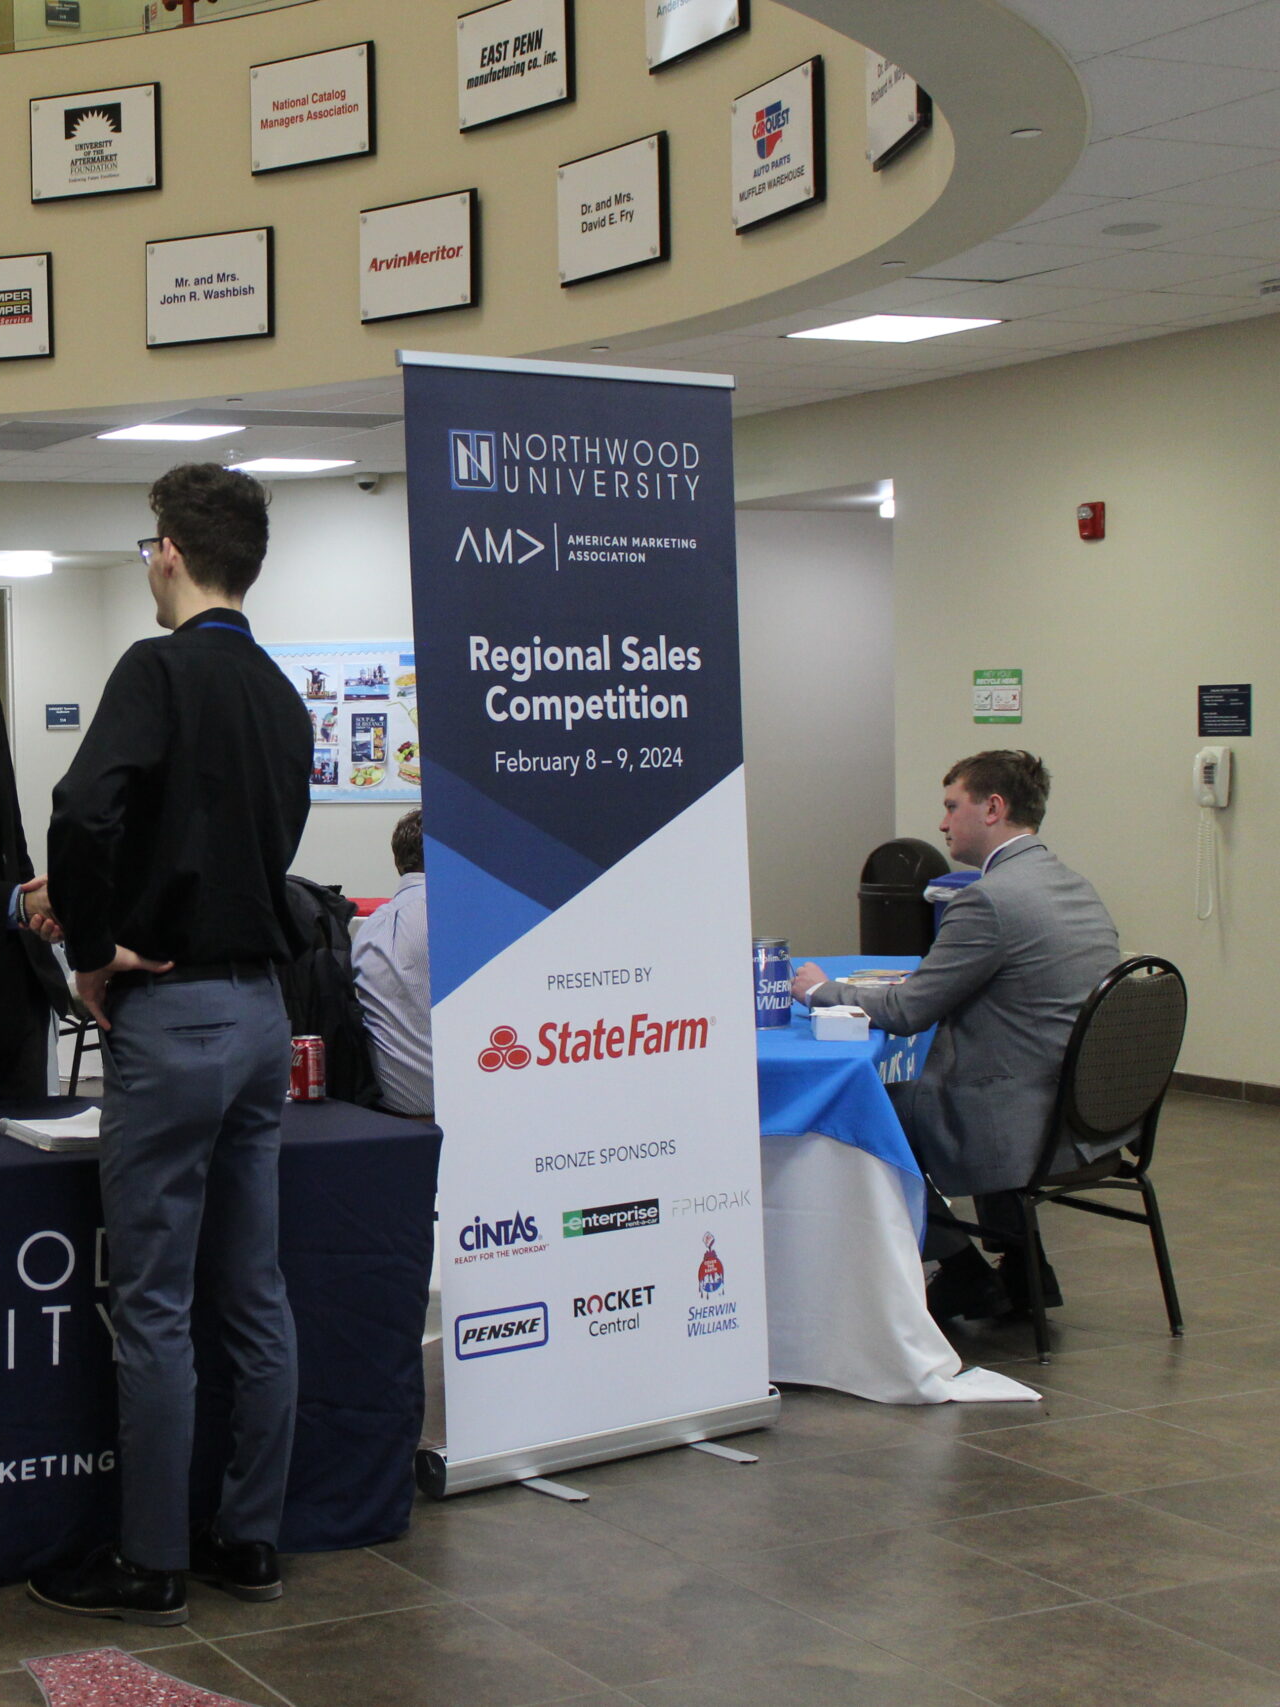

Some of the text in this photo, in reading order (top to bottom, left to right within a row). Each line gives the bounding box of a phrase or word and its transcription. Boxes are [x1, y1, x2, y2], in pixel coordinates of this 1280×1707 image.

[480, 28, 543, 68] EAST PENN
[466, 60, 525, 90] manufacturing
[543, 50, 558, 65] inc.
[272, 89, 346, 111] National Catalog
[260, 103, 359, 130] Managers Association
[752, 107, 790, 141] CARQUEST
[75, 139, 112, 151] UNIVERSITY
[70, 153, 118, 167] AFTERMARKET
[70, 162, 118, 175] FOUNDATION
[753, 153, 791, 179] AUTO PARTS
[739, 165, 806, 202] MUFFLER WAREHOUSE
[581, 192, 634, 216] Dr. and Mrs.
[581, 209, 634, 233] David E. Fry
[368, 245, 464, 272] ArvinMeritor
[175, 272, 239, 288] Mr. and Mrs.
[160, 285, 255, 305] John R. Washbish
[0, 316, 30, 324] Service
[502, 431, 699, 469] NORTHWOOD
[503, 465, 699, 500] UNIVERSITY
[567, 534, 697, 549] AMERICAN MARKETING
[568, 551, 646, 563] ASSOCIATION
[470, 635, 702, 682] Regional Sales
[485, 685, 688, 730] Competition
[495, 749, 580, 776] February
[639, 747, 683, 769] 2024
[547, 967, 652, 990] PRESENTED BY
[535, 1139, 677, 1173] BRONZE SPONSORS
[567, 1206, 658, 1231] enterprise
[625, 1217, 658, 1227] rent-a-car
[454, 1244, 548, 1264] READY FOR THE WORKDAY
[573, 1285, 655, 1317] ROCKET
[688, 1302, 737, 1321] SHERWIN
[462, 1317, 541, 1345] PENSKE
[588, 1312, 640, 1336] Central
[687, 1318, 737, 1337] WILLIAMS
